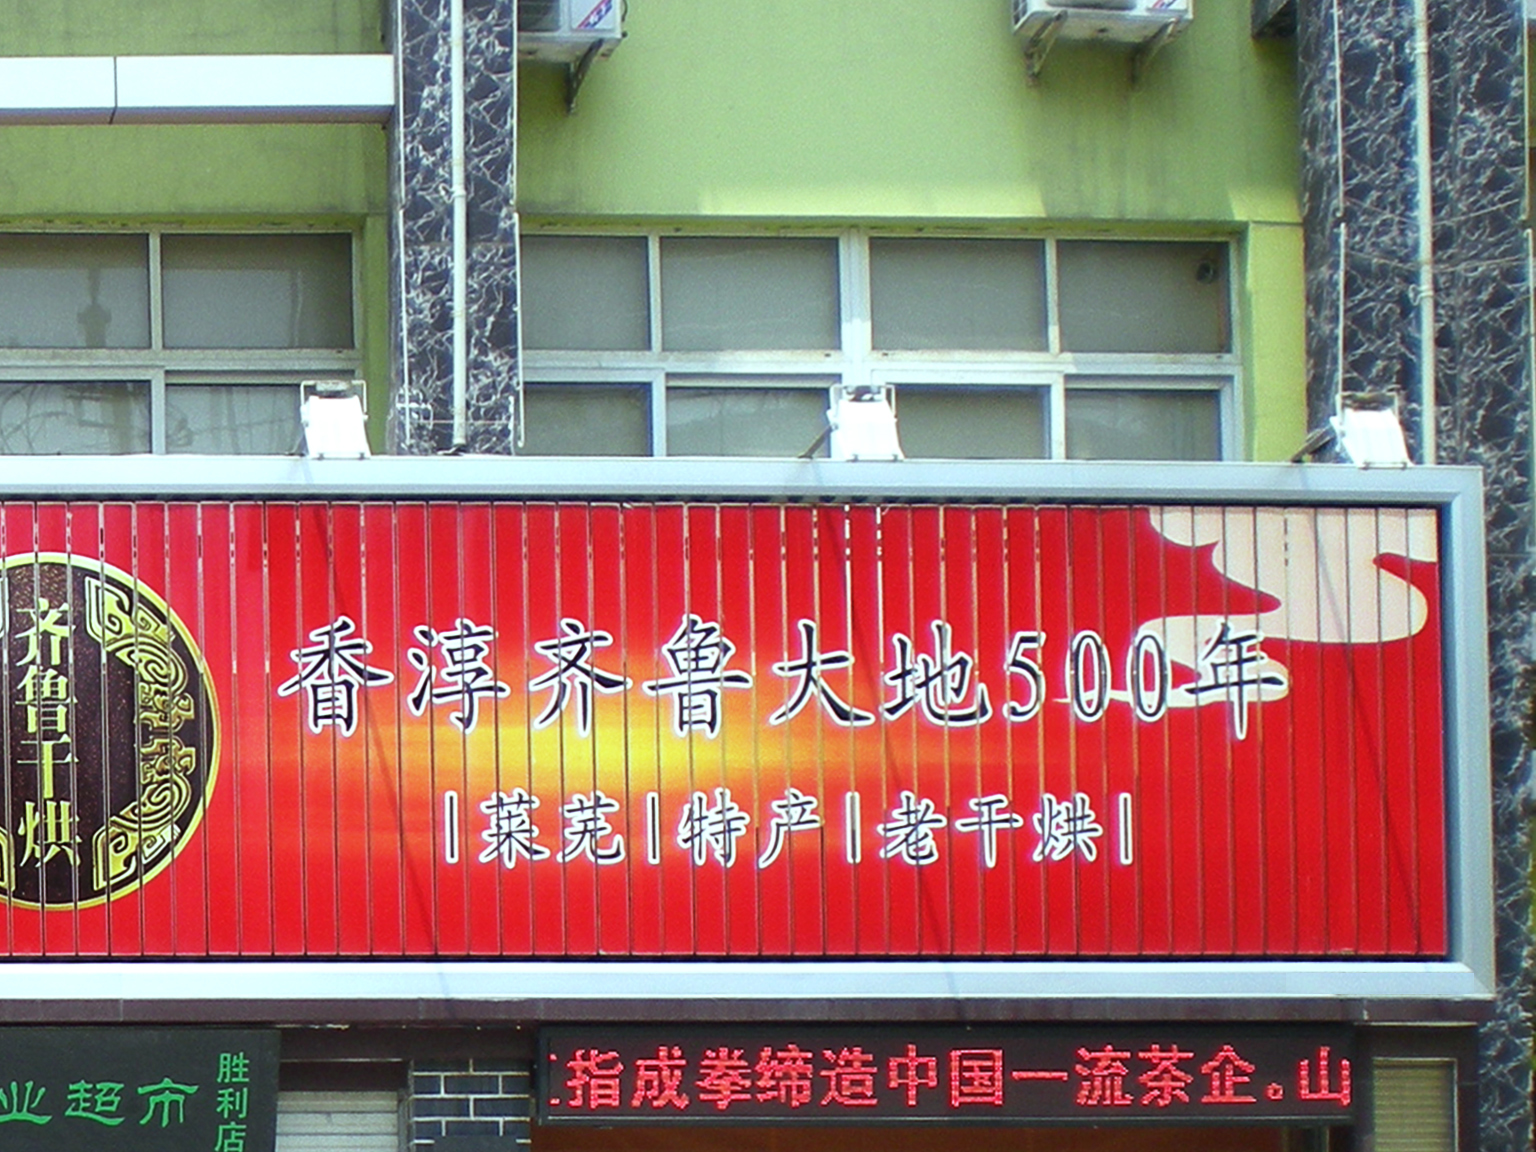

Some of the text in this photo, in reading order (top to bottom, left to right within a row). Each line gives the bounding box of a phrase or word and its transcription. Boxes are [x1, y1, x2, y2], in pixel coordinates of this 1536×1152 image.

[277, 612, 1288, 740] 香淳齐鲁大地500年
[15, 597, 82, 868] 齐鲁干烘
[478, 788, 1104, 869] 莱芜 特产 老干烘
[548, 1044, 1352, 1110] 指成拳缔造中国一流茶企。山
